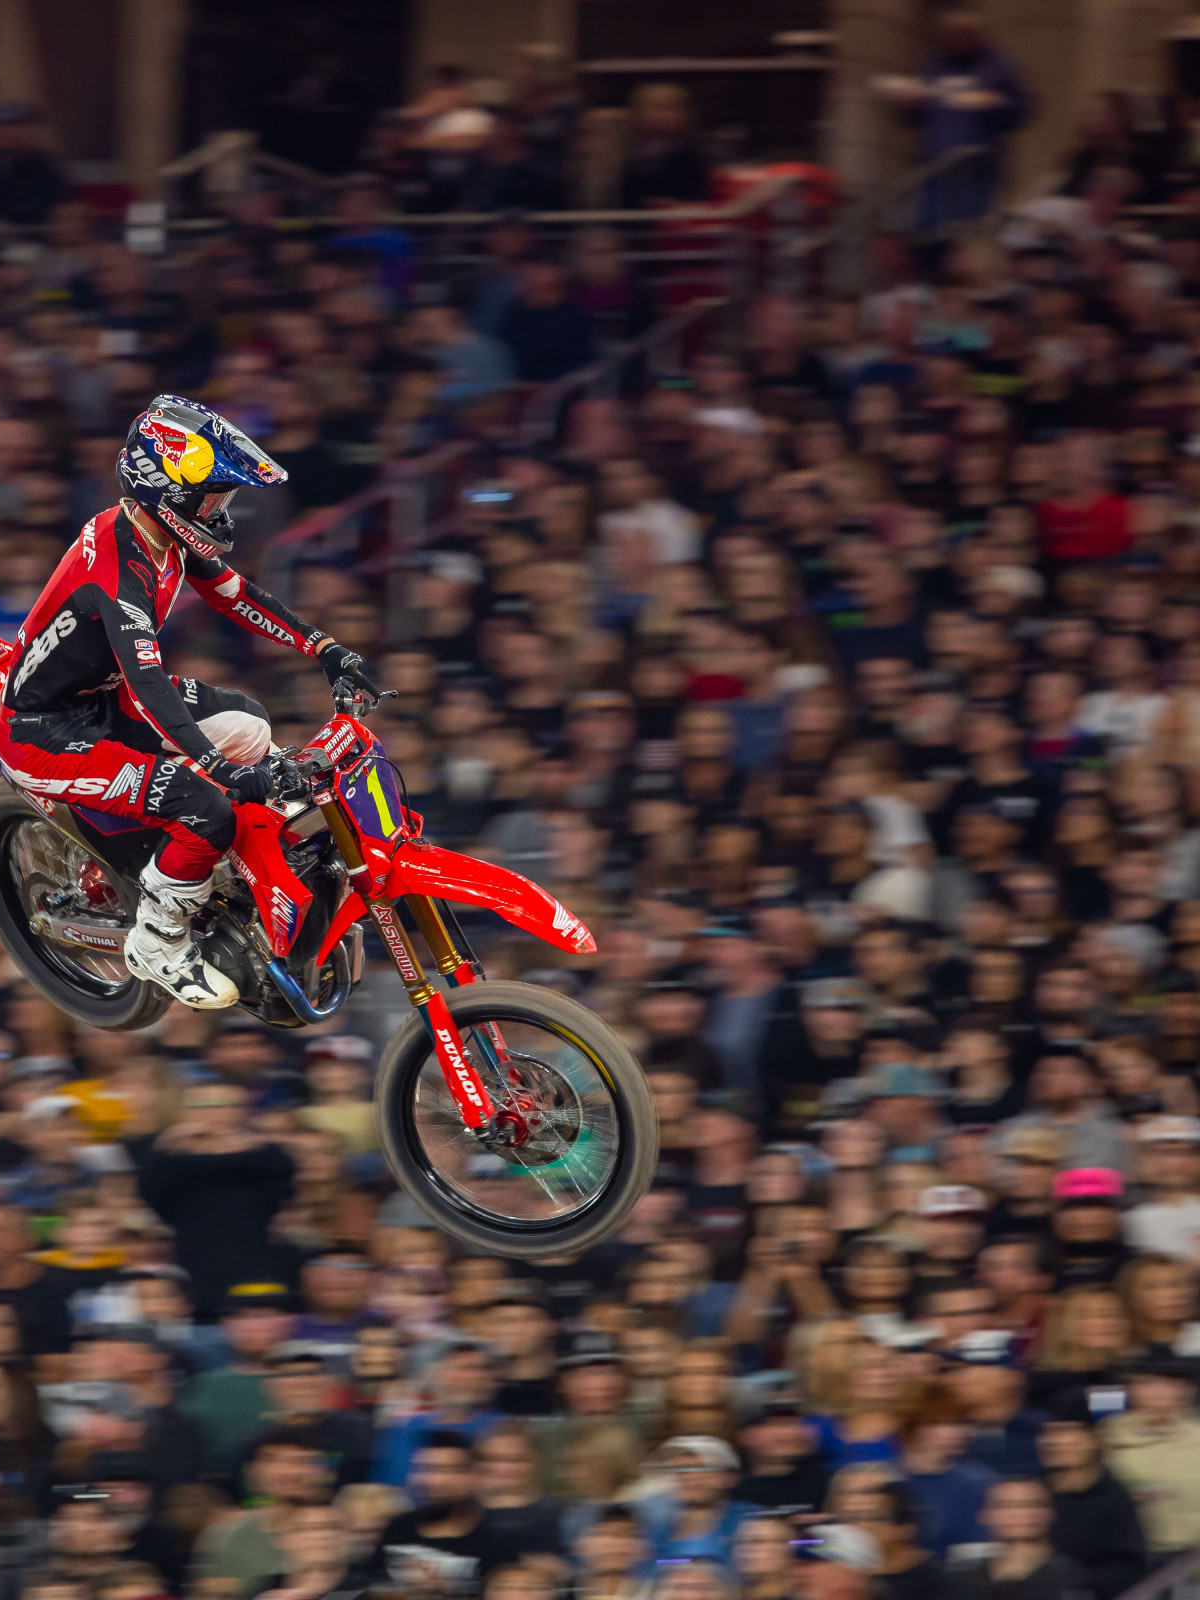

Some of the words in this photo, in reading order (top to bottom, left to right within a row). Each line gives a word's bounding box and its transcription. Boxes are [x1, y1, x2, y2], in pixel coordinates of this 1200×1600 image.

[324, 723, 353, 753] RENTHAL
[330, 731, 356, 762] RENTHAL
[128, 763, 146, 805] HONDA
[366, 765, 397, 837] 1
[382, 926, 418, 982] SHOWA
[436, 1028, 483, 1107] DUNLOP
